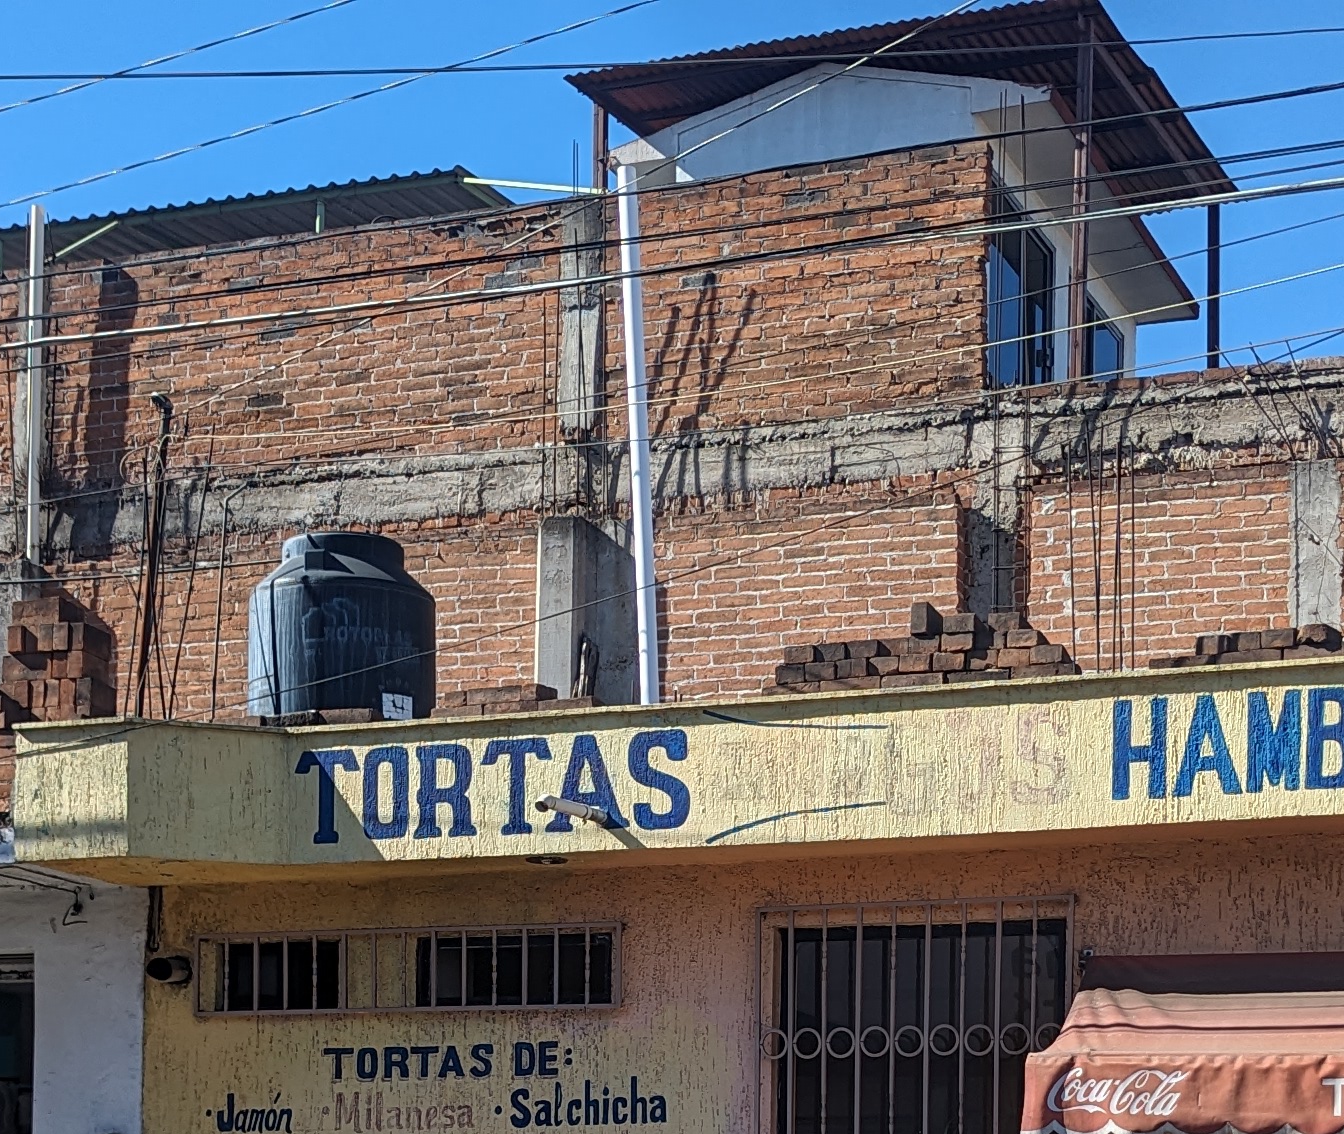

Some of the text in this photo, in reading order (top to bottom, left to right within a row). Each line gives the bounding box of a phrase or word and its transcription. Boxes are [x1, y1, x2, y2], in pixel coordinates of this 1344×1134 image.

[295, 728, 691, 844] TORTAS
[323, 1041, 573, 1082] TORTAS DE:
[216, 1076, 668, 1134] Jamón Milanesa Salchicha
[1047, 1067, 1191, 1116] Coca-Cola
